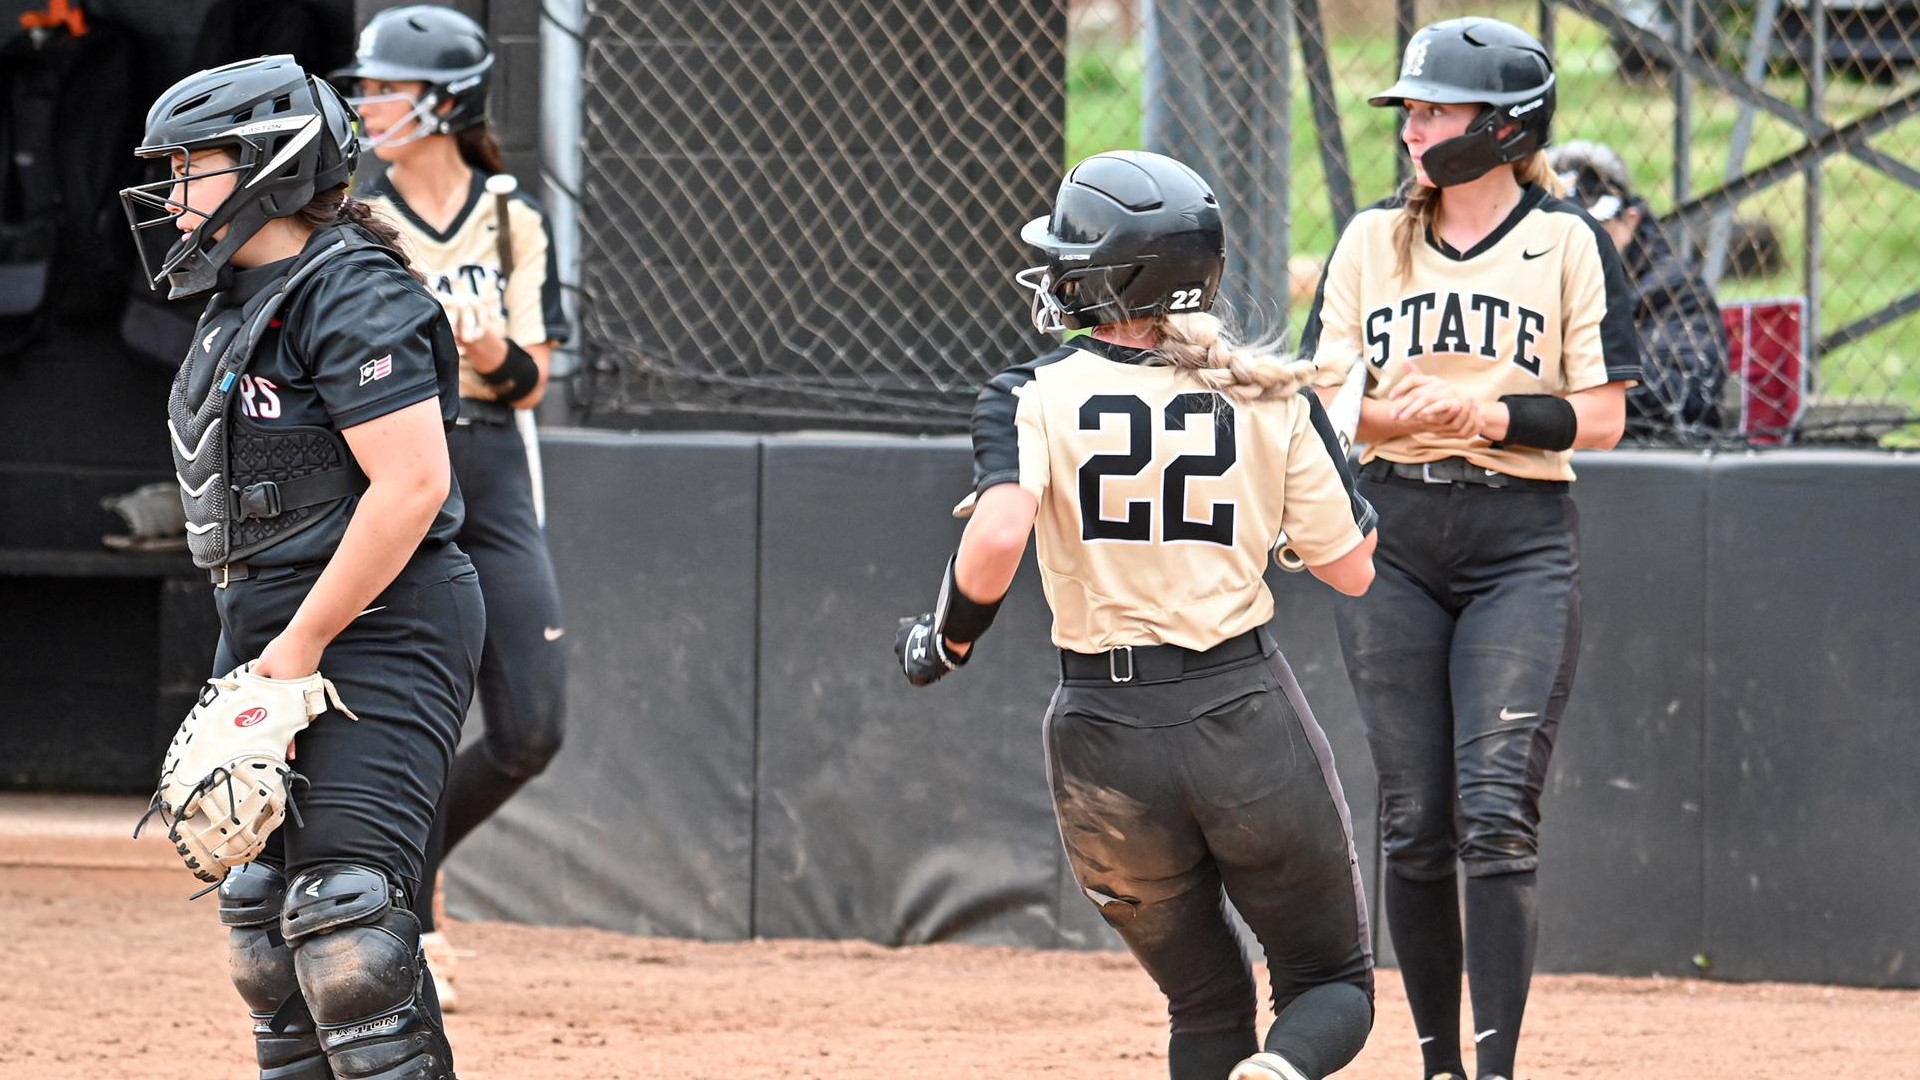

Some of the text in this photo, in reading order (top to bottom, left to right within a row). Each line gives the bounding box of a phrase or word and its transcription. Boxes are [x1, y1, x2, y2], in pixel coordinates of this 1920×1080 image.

[1169, 288, 1202, 310] 22
[1366, 292, 1545, 377] STATE
[1078, 392, 1237, 547] 22
[328, 1015, 399, 1039] EASTON
